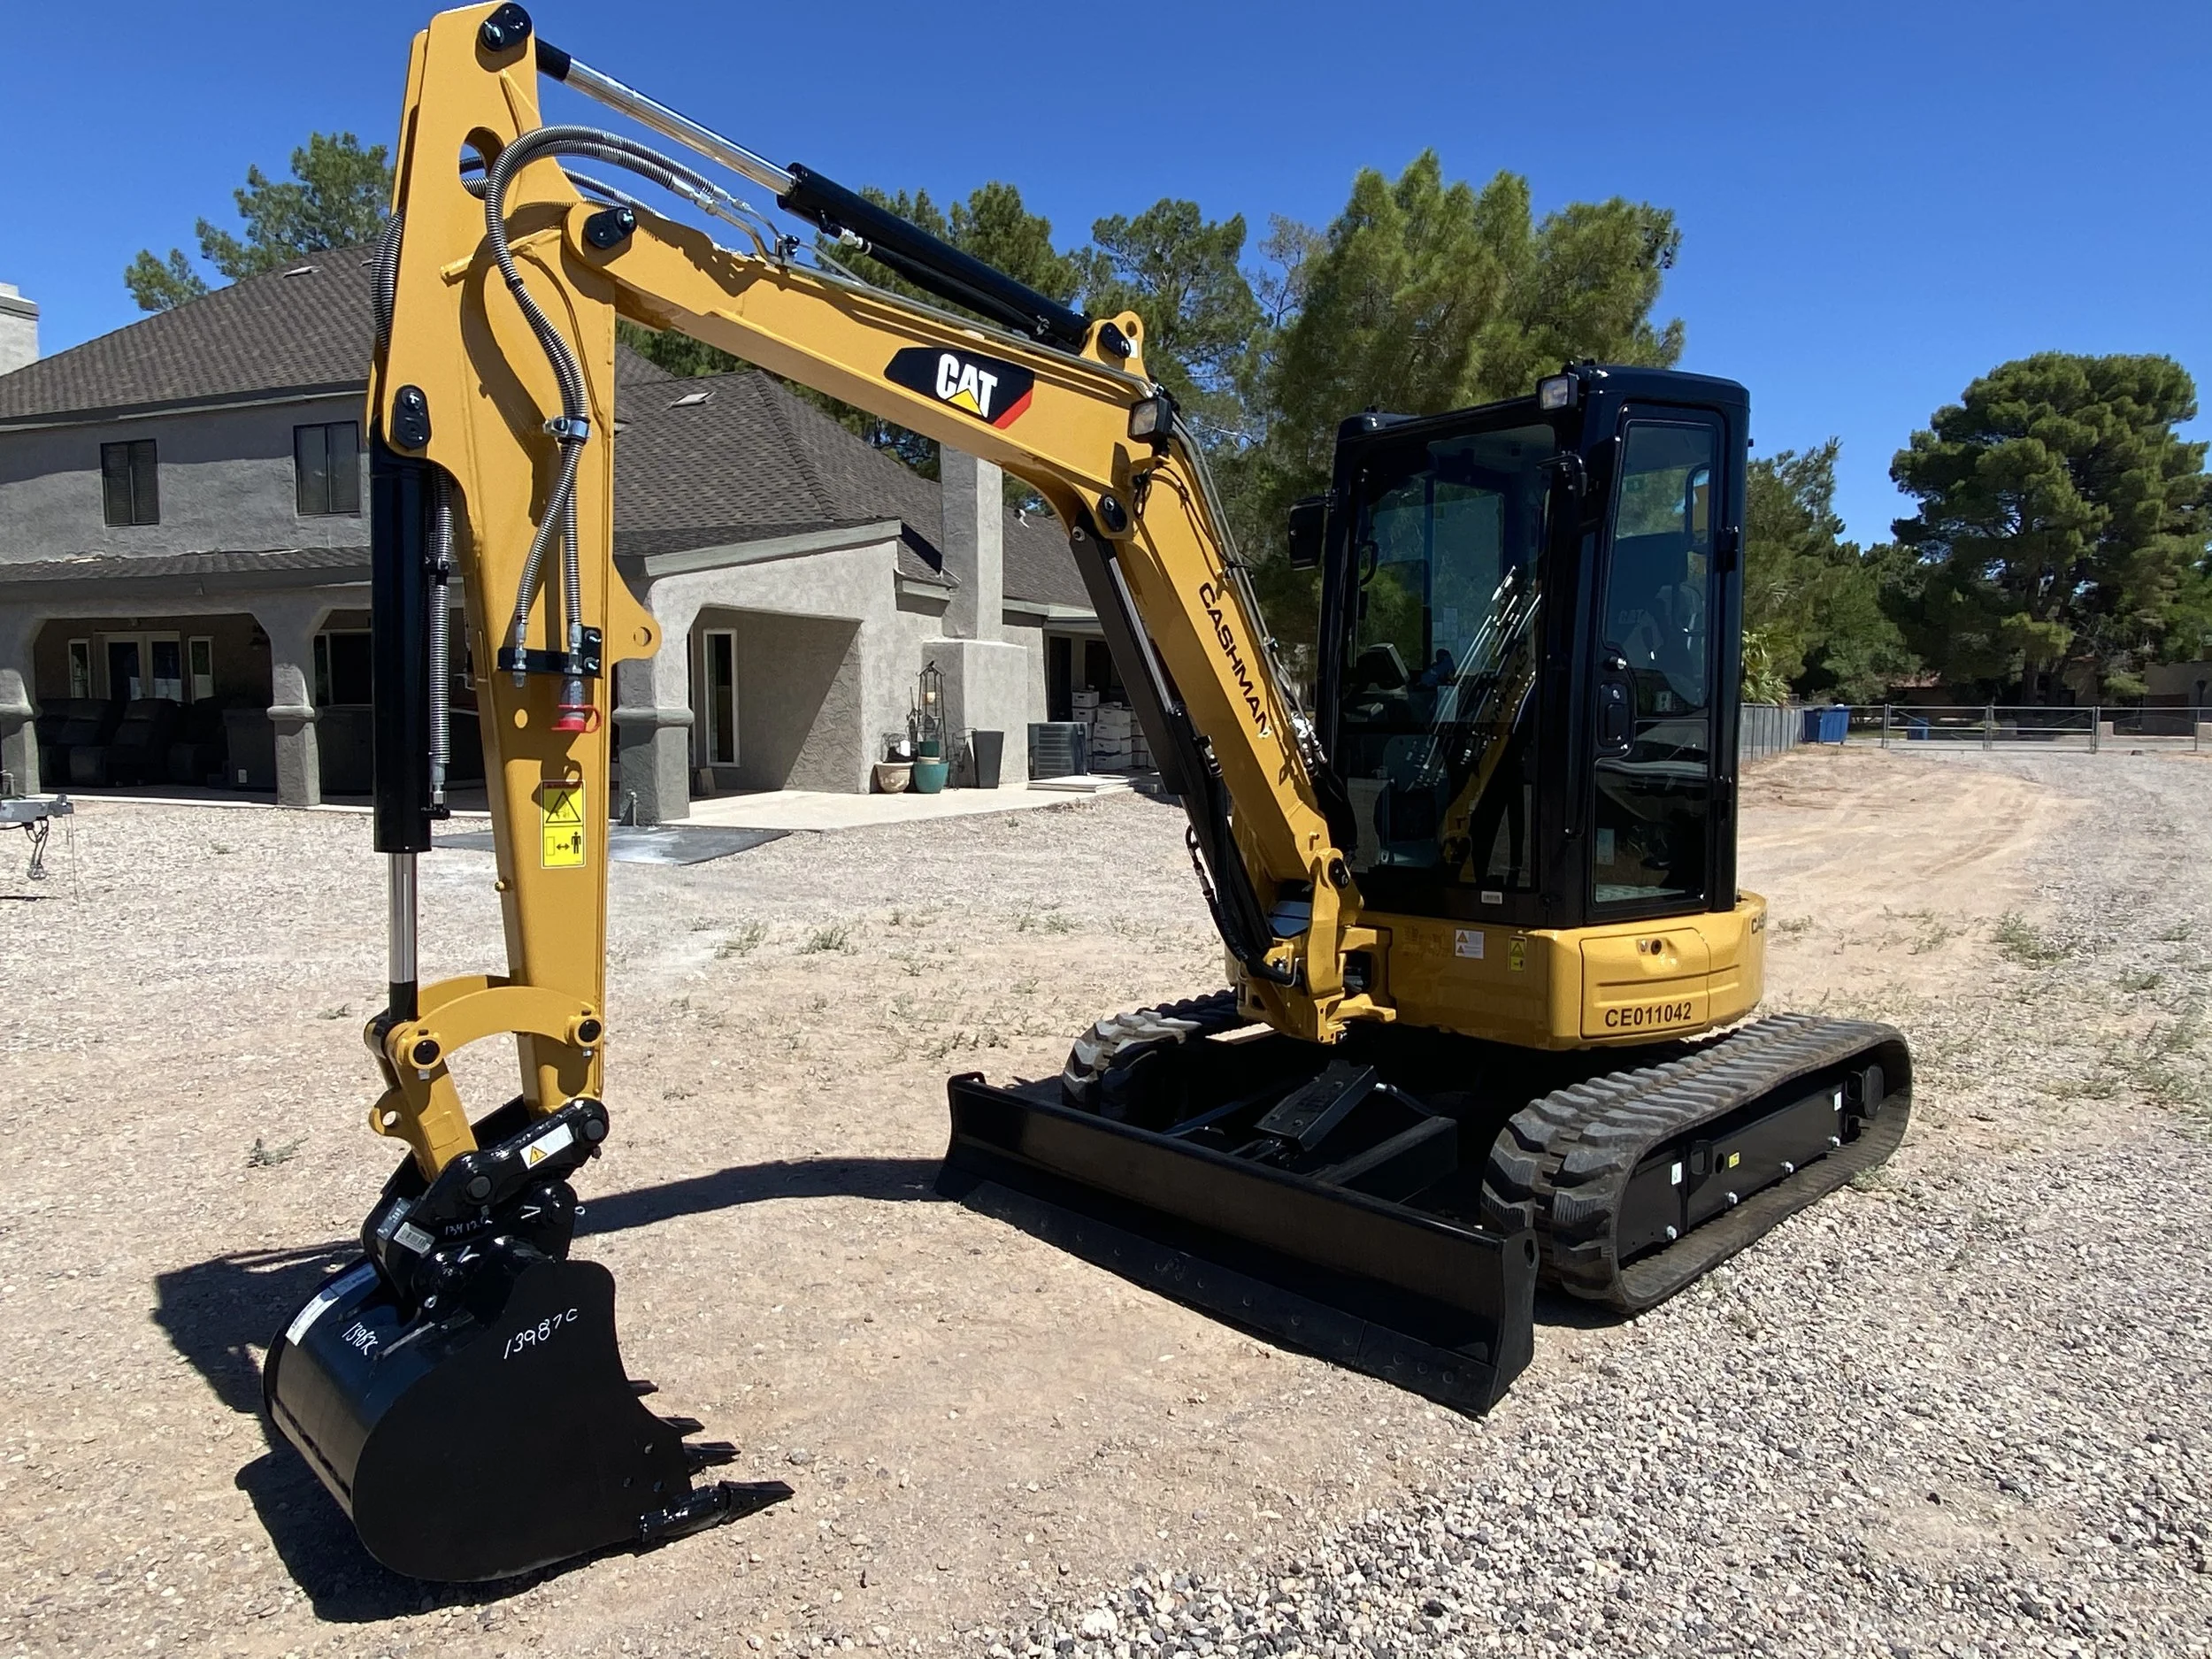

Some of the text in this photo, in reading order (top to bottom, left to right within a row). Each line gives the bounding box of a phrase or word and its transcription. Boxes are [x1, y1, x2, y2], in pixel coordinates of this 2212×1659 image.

[936, 353, 998, 419] CAT
[1199, 582, 1270, 734] CASHMAN
[1605, 1002, 1692, 1027] CE011042
[503, 1308, 579, 1360] 13987C
